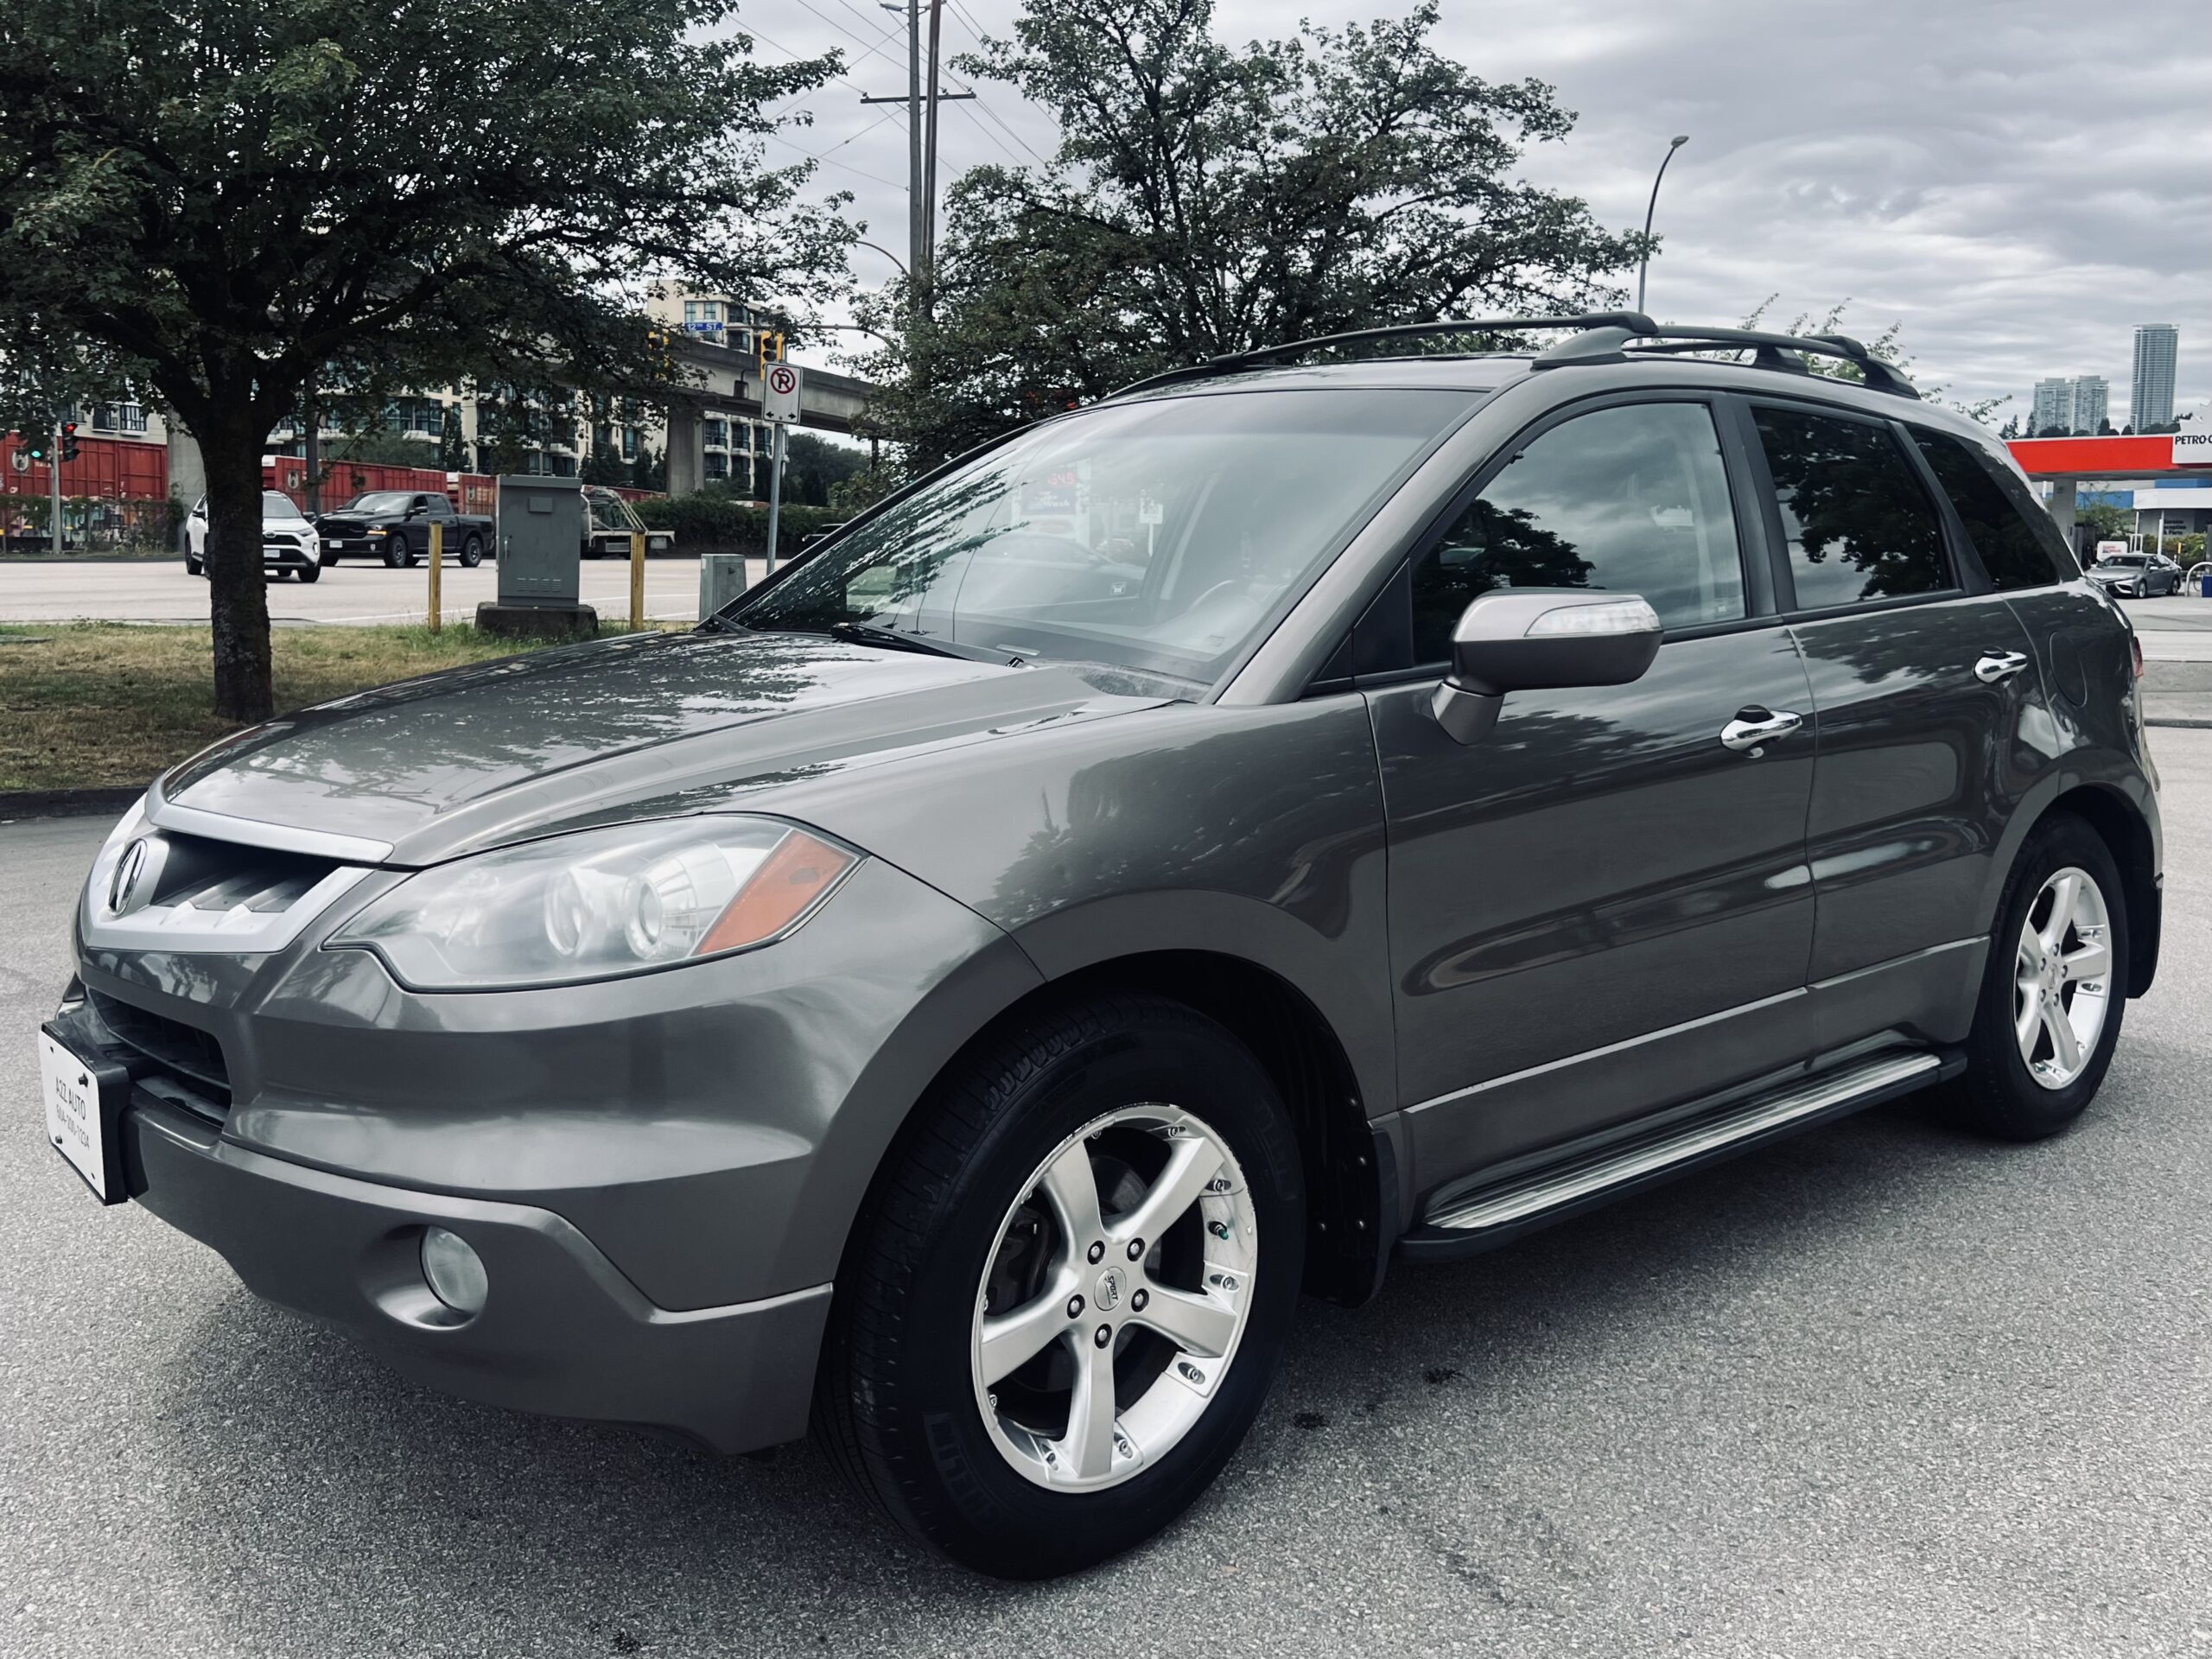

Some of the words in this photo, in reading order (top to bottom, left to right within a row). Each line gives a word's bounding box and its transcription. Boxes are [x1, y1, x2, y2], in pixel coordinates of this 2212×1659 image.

[2175, 435, 2206, 445] PETRO
[56, 1076, 67, 1103] A2Z
[69, 1088, 86, 1121] AUTO
[1107, 1274, 1118, 1300] SPORT
